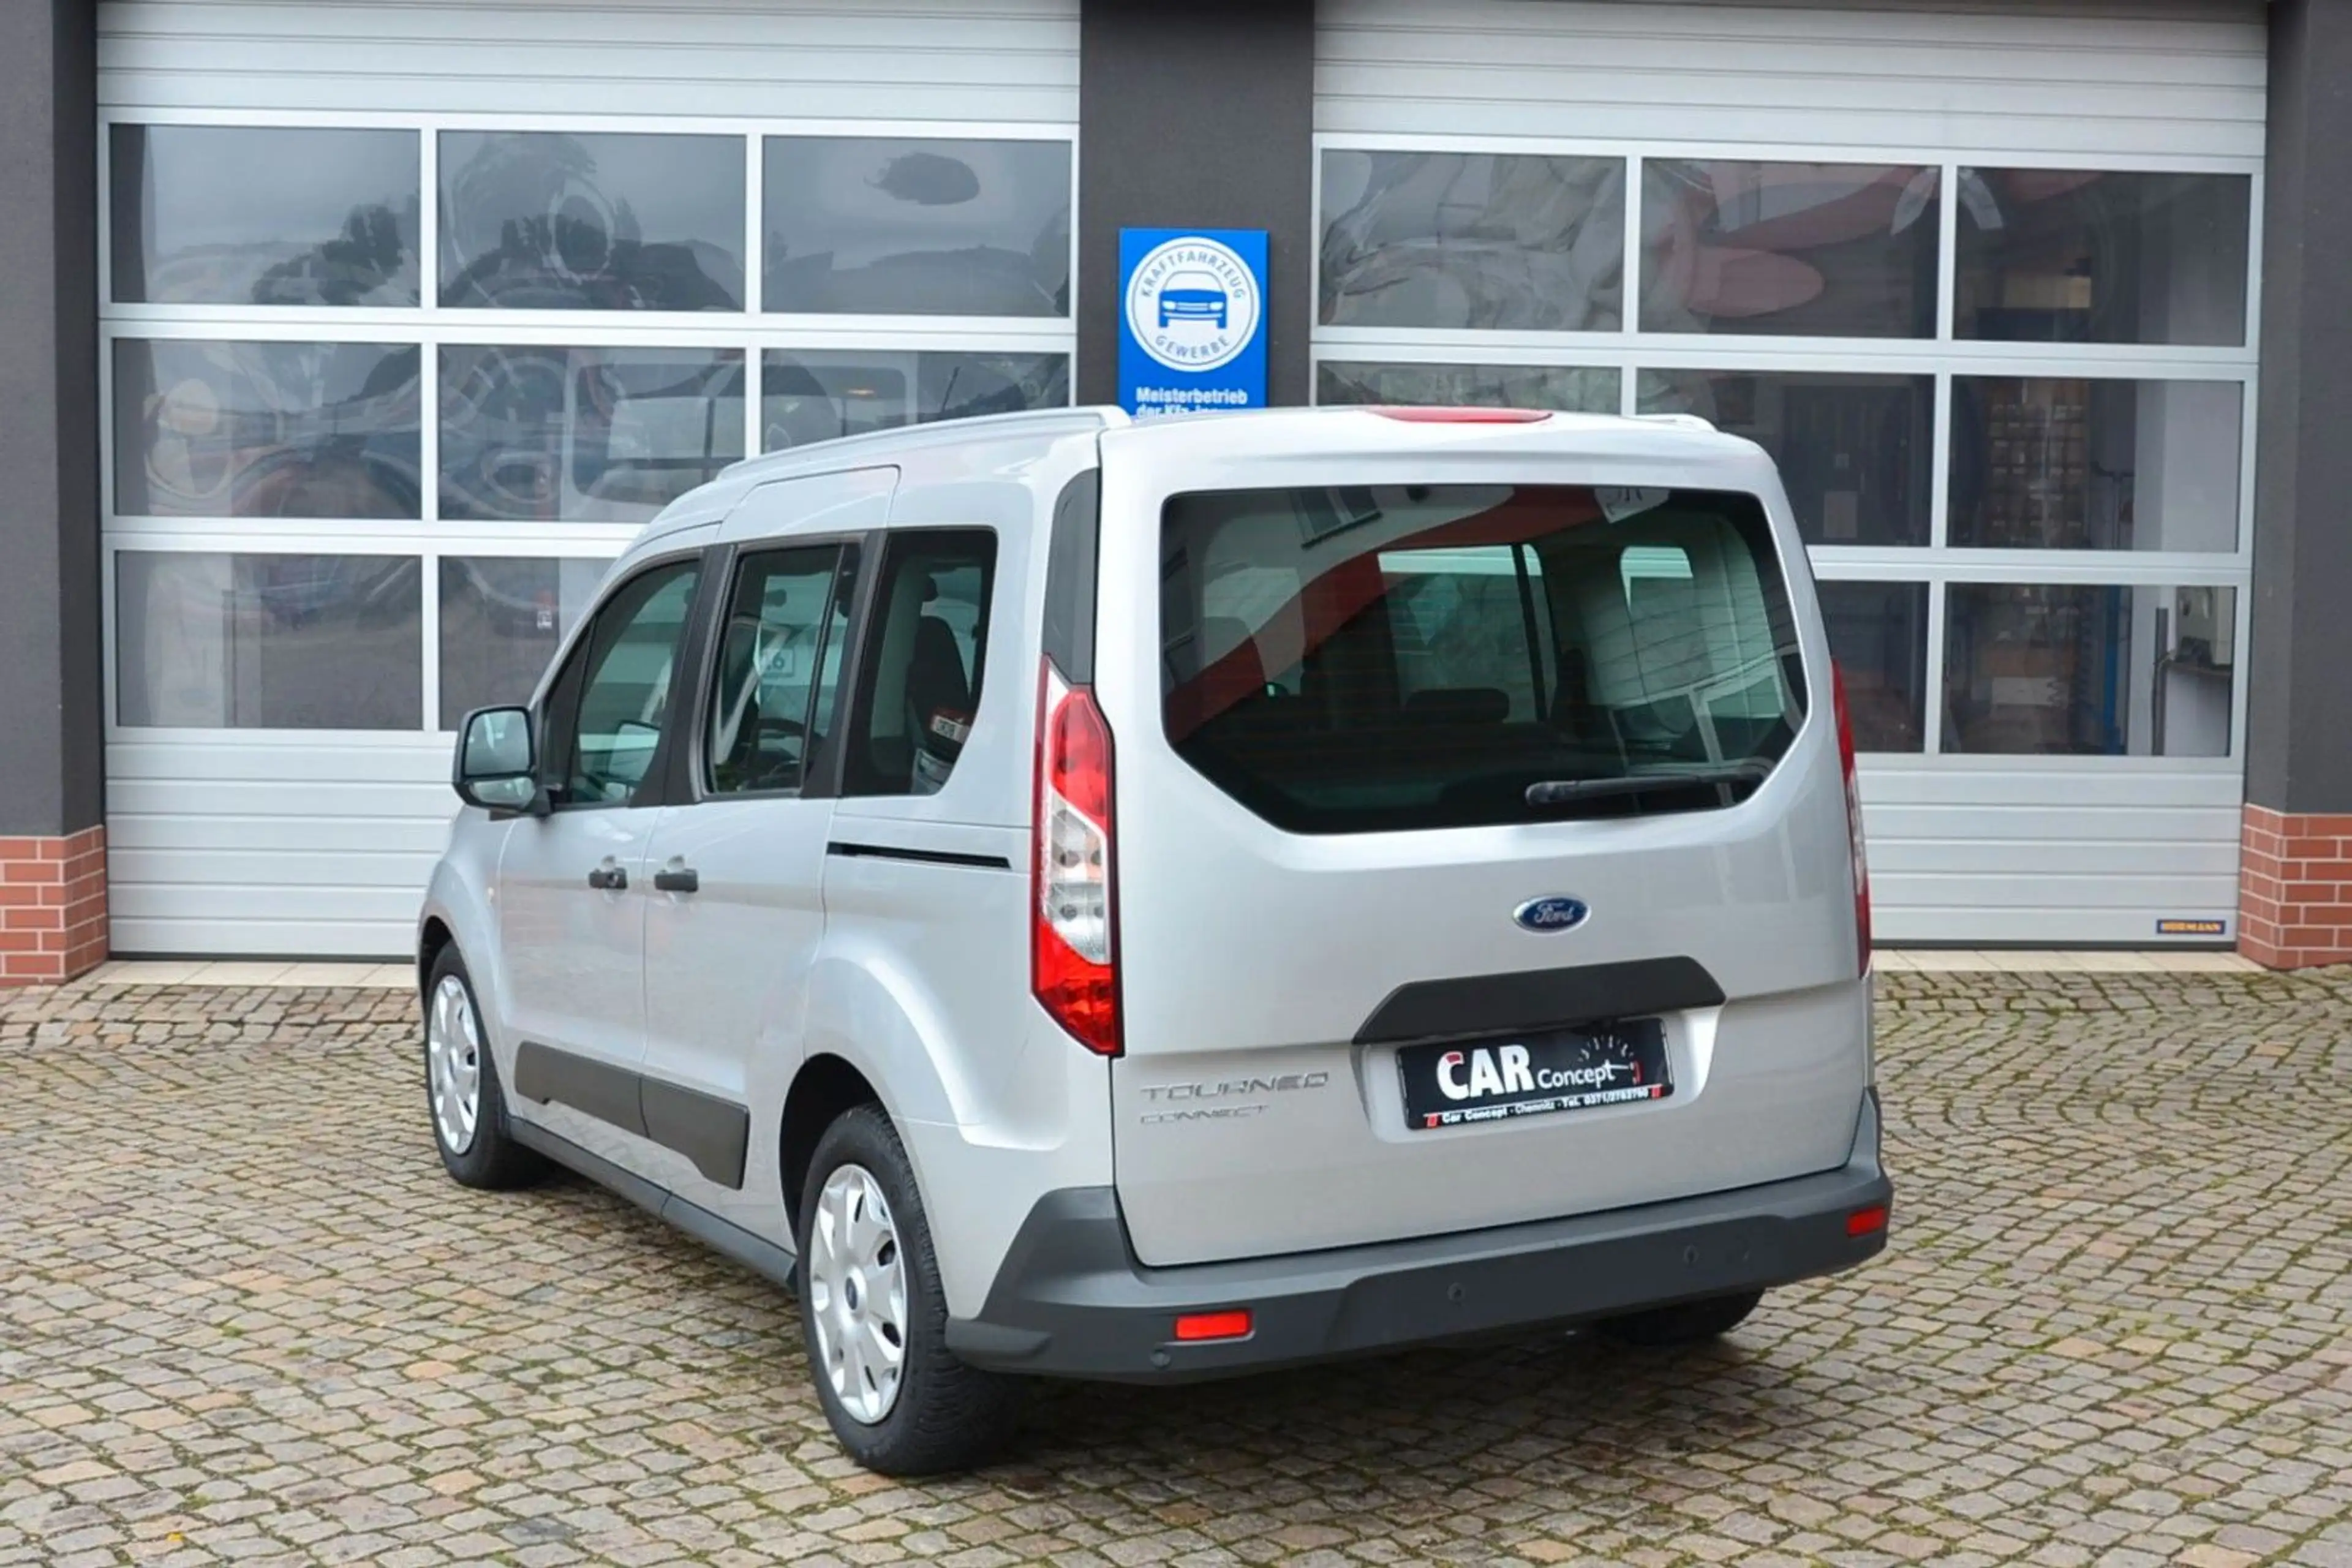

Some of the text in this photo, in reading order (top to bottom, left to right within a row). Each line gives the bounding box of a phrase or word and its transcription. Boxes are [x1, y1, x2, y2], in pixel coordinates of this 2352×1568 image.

[1140, 250, 1246, 299] KRAFTFAHRZEUG
[1155, 334, 1229, 358] GEWERBE
[1136, 386, 1248, 404] Meisterbetrieb
[1534, 902, 1575, 923] Ford
[1436, 1044, 1616, 1100] CAR Concept
[1140, 1072, 1329, 1099] TOURNEO
[1140, 1105, 1268, 1124] CONNECT
[1442, 1113, 1462, 1123] Car
[1464, 1108, 1507, 1121] Concept
[1515, 1101, 1556, 1114] Chemnitz
